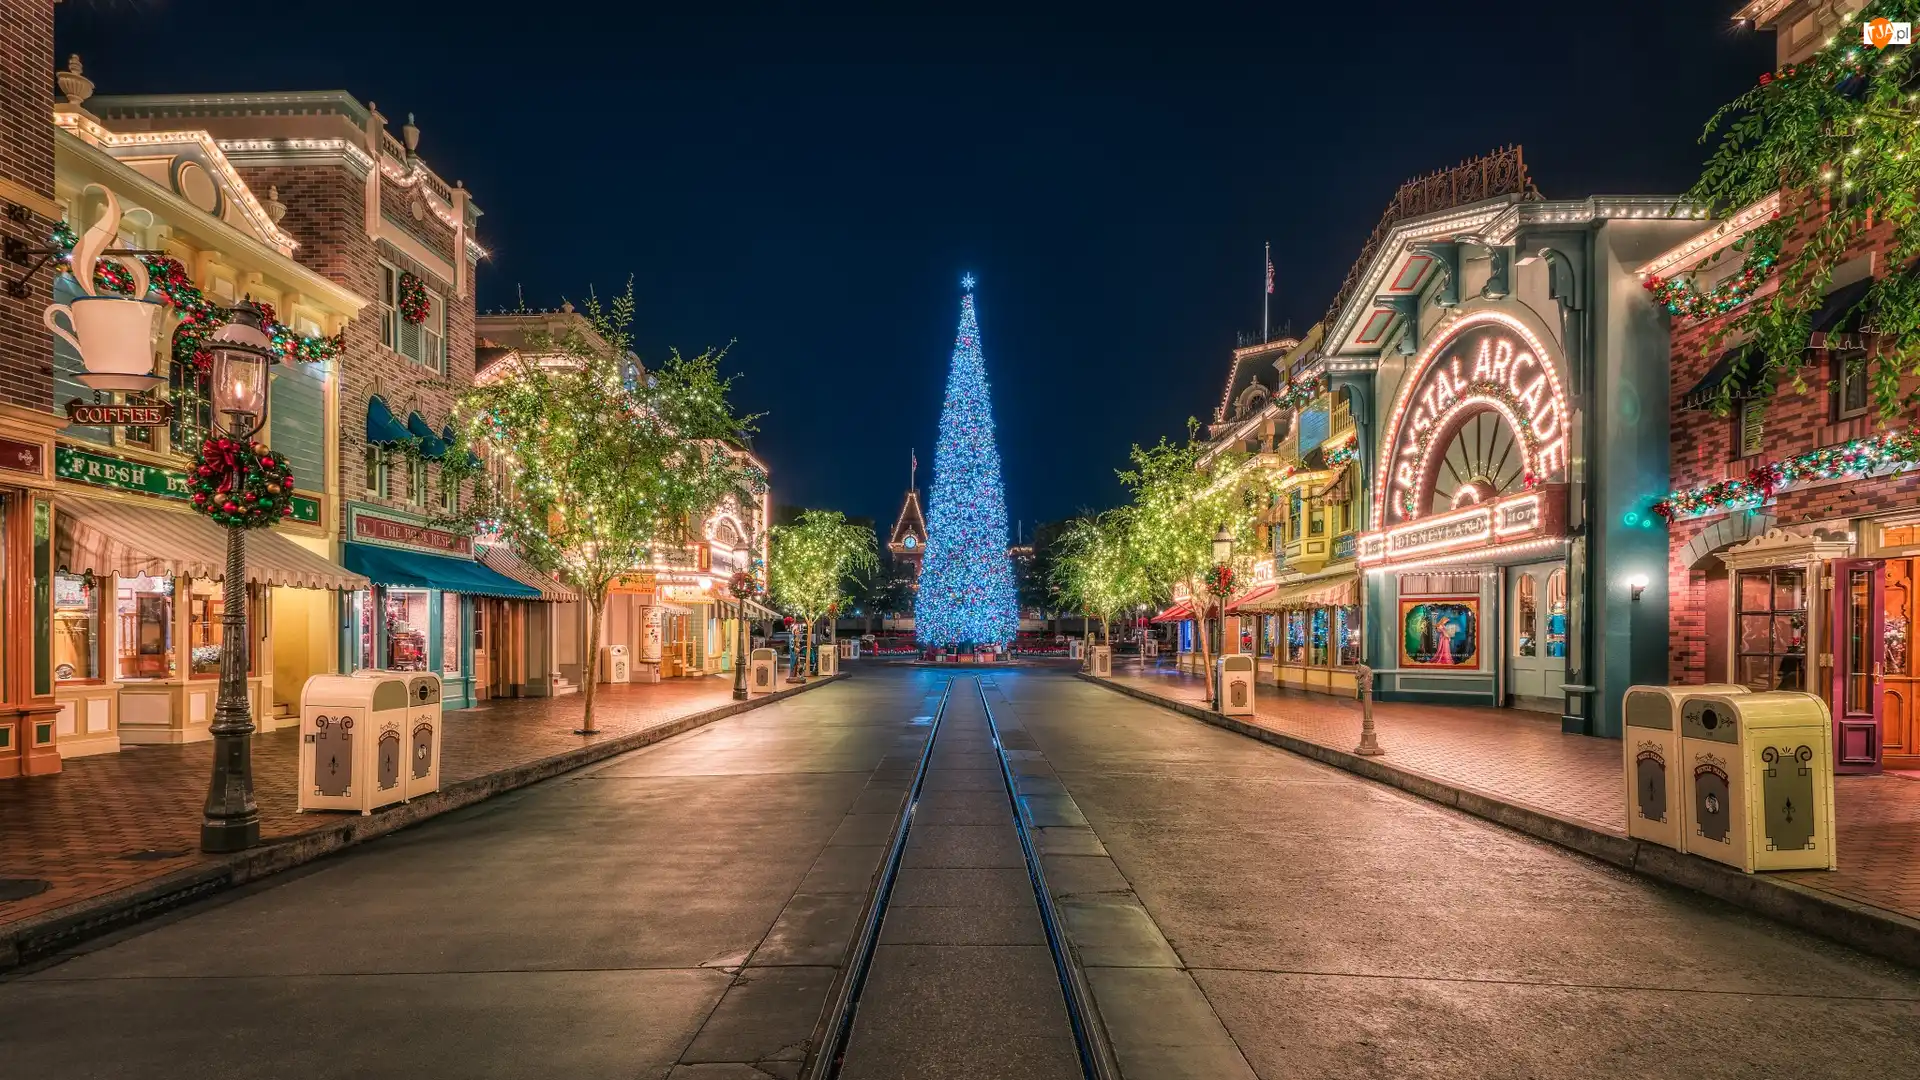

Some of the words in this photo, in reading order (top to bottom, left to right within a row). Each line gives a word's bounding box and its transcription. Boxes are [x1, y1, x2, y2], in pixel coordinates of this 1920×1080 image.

[76, 407, 161, 423] COFFEE
[1394, 356, 1467, 516] CRYSTAL
[1472, 338, 1565, 479] ARCADE
[71, 456, 145, 486] FRESH
[381, 523, 401, 539] THE
[431, 532, 450, 547] REST
[1395, 517, 1485, 548] DISNEYLAND
